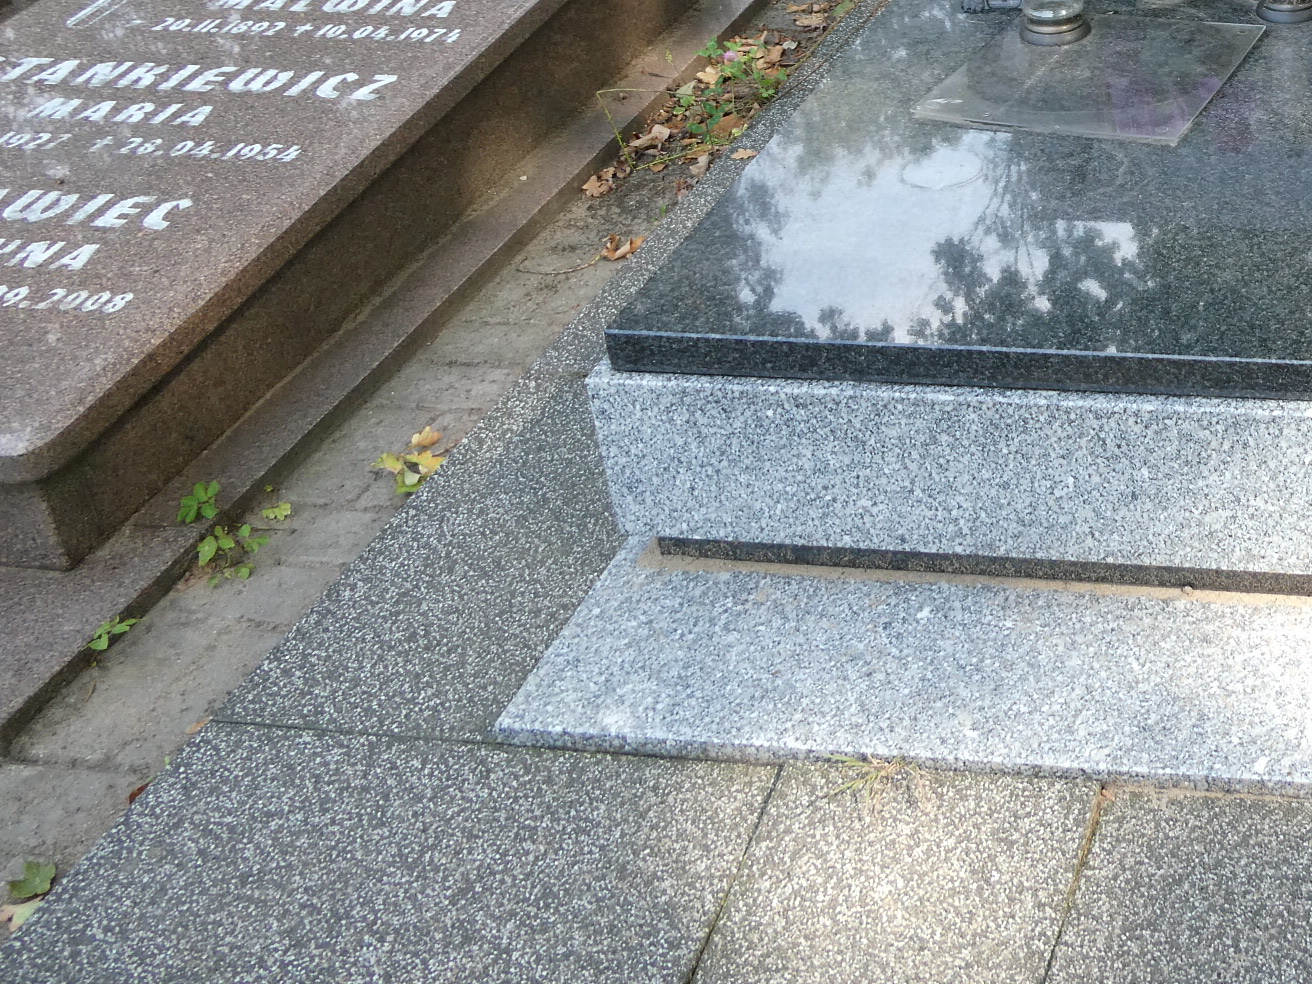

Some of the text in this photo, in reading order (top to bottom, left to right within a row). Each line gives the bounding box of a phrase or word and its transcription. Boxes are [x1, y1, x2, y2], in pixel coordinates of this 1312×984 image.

[150, 17, 461, 43] 20.11.1892 10.04.1974
[0, 56, 398, 100] TANKIEWICZ
[27, 97, 213, 126] MARIA
[0, 188, 193, 231] WIEC
[0, 284, 134, 314] 9.2008
